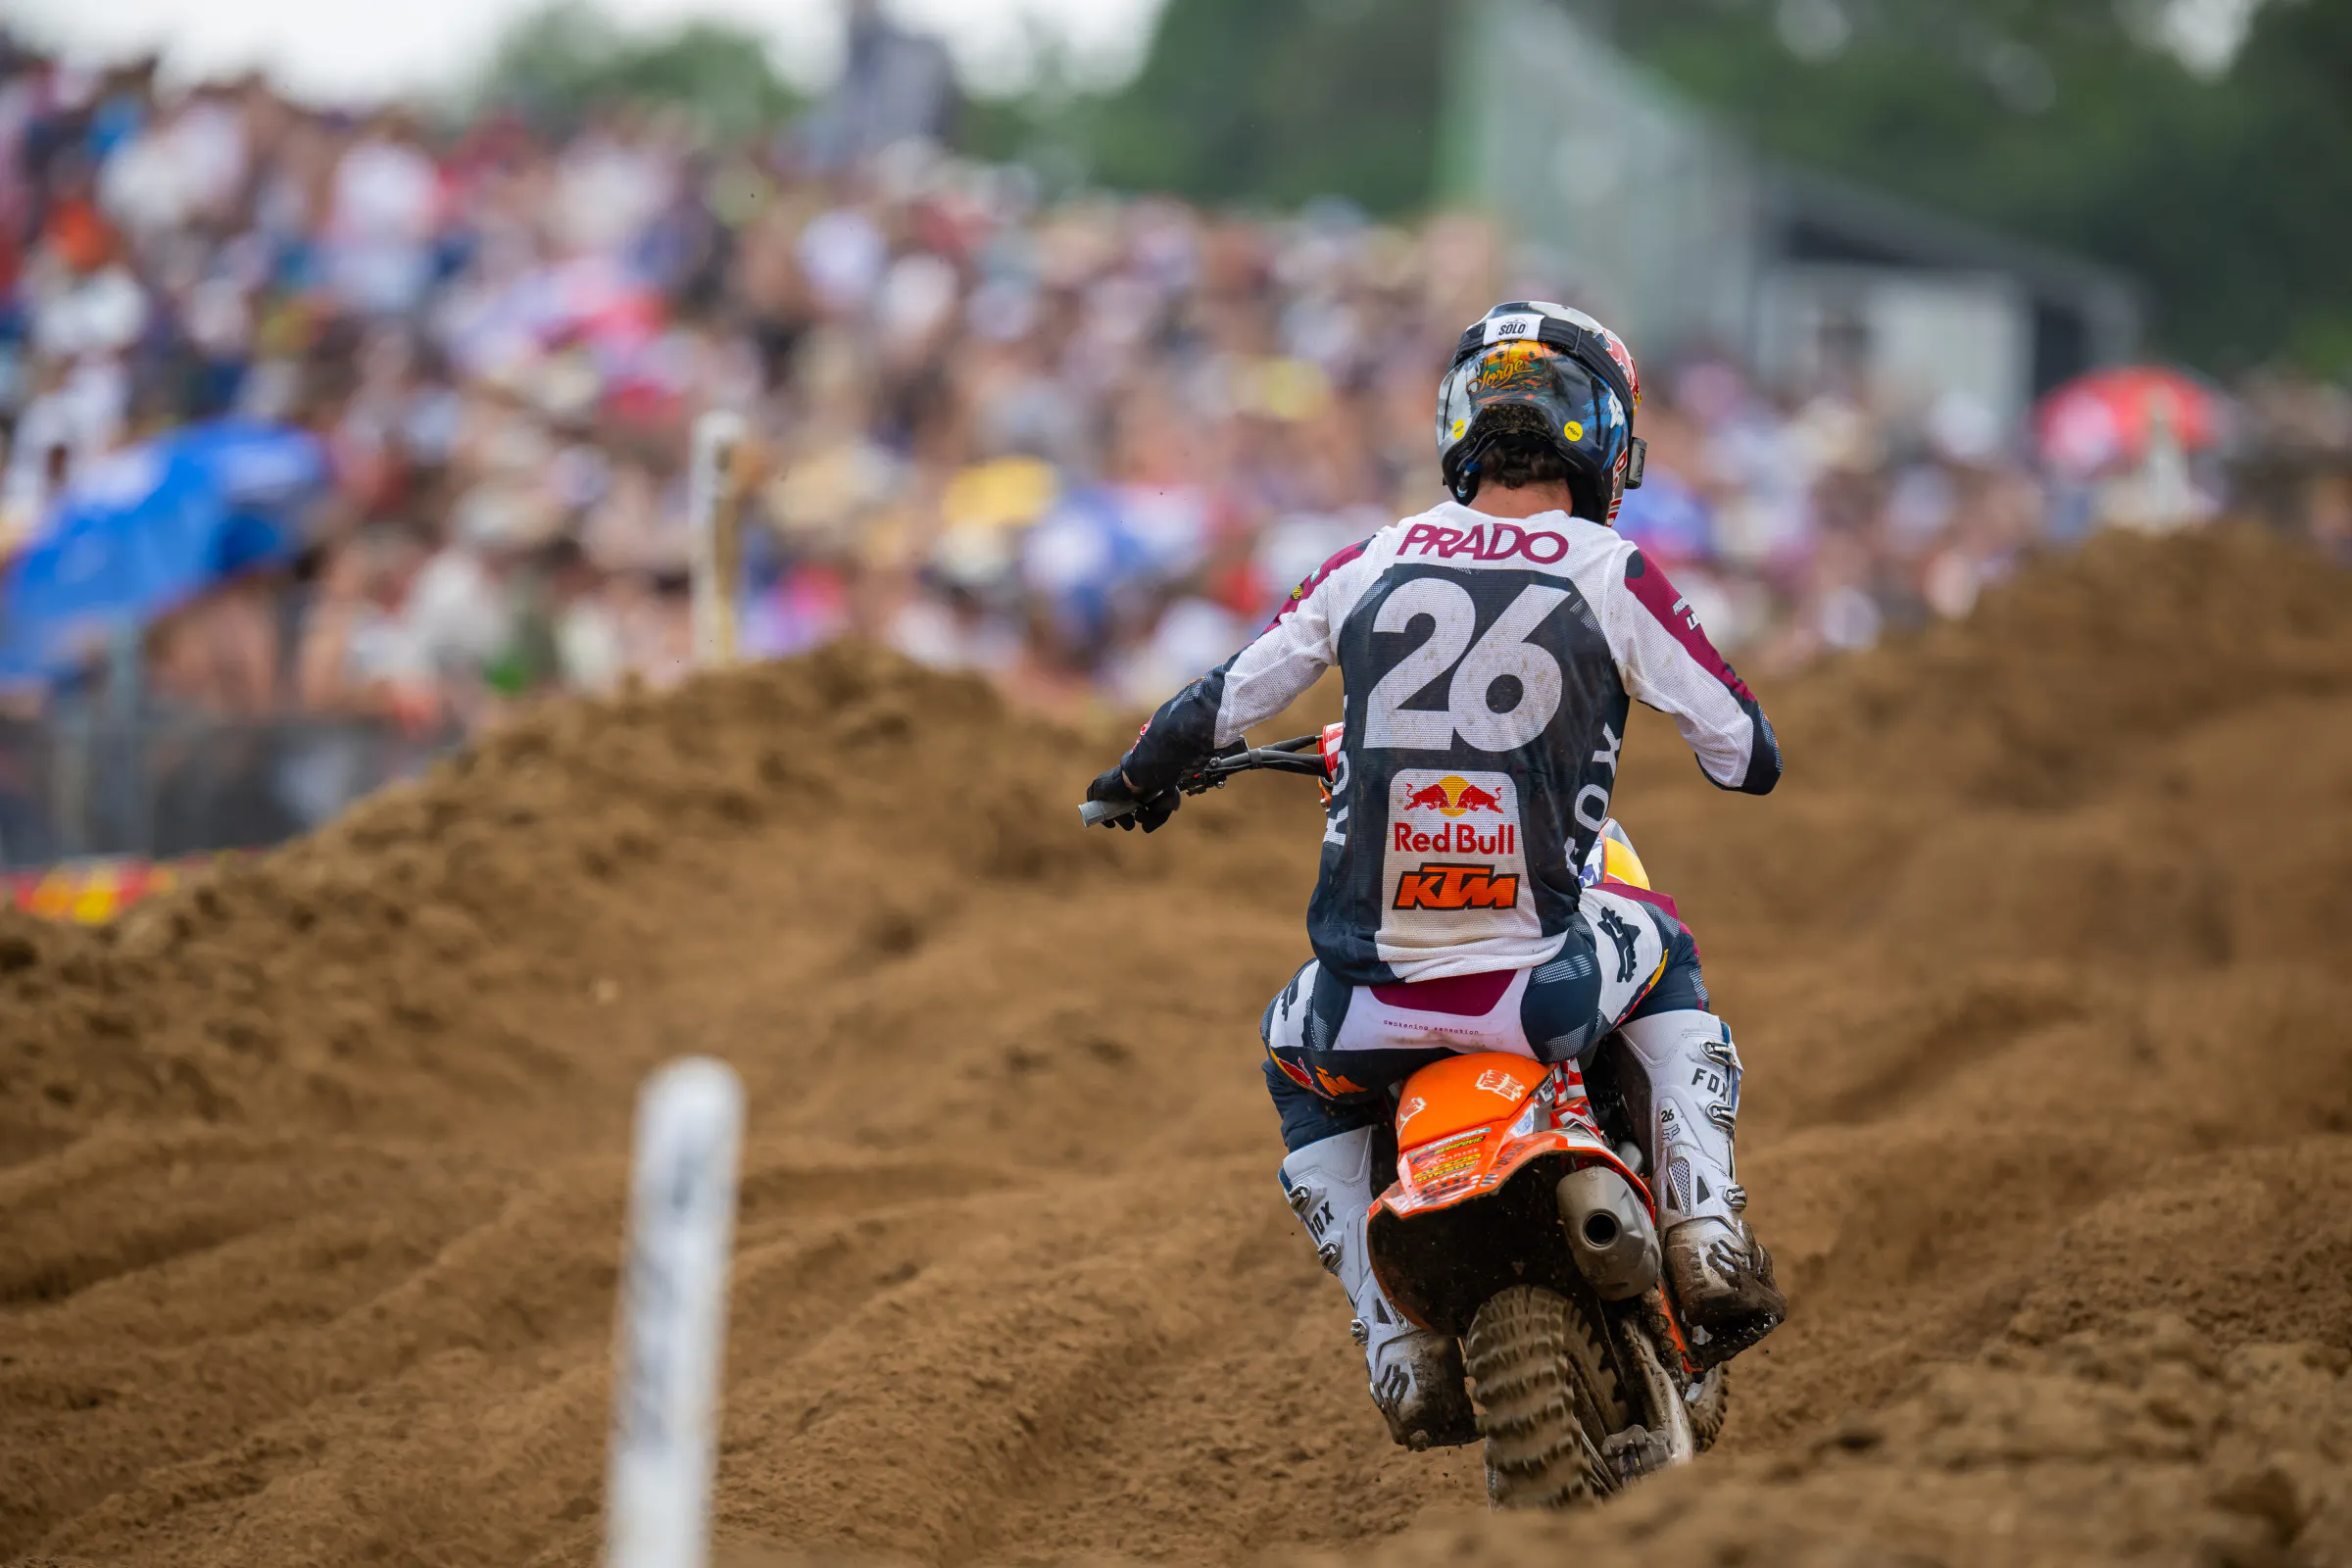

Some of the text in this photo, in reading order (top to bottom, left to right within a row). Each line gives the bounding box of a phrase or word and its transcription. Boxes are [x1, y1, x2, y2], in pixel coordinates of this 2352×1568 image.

[1498, 323, 1526, 336] SOLO
[1466, 359, 1535, 394] Jorge
[1396, 522, 1569, 564] PRADO
[1363, 577, 1571, 752] 26
[1395, 821, 1515, 855] Red Bull
[1392, 862, 1520, 910] KTM
[1383, 1019, 1479, 1035] awakening sensation
[1690, 1067, 1728, 1102] FOX
[1660, 1108, 1675, 1124] 26
